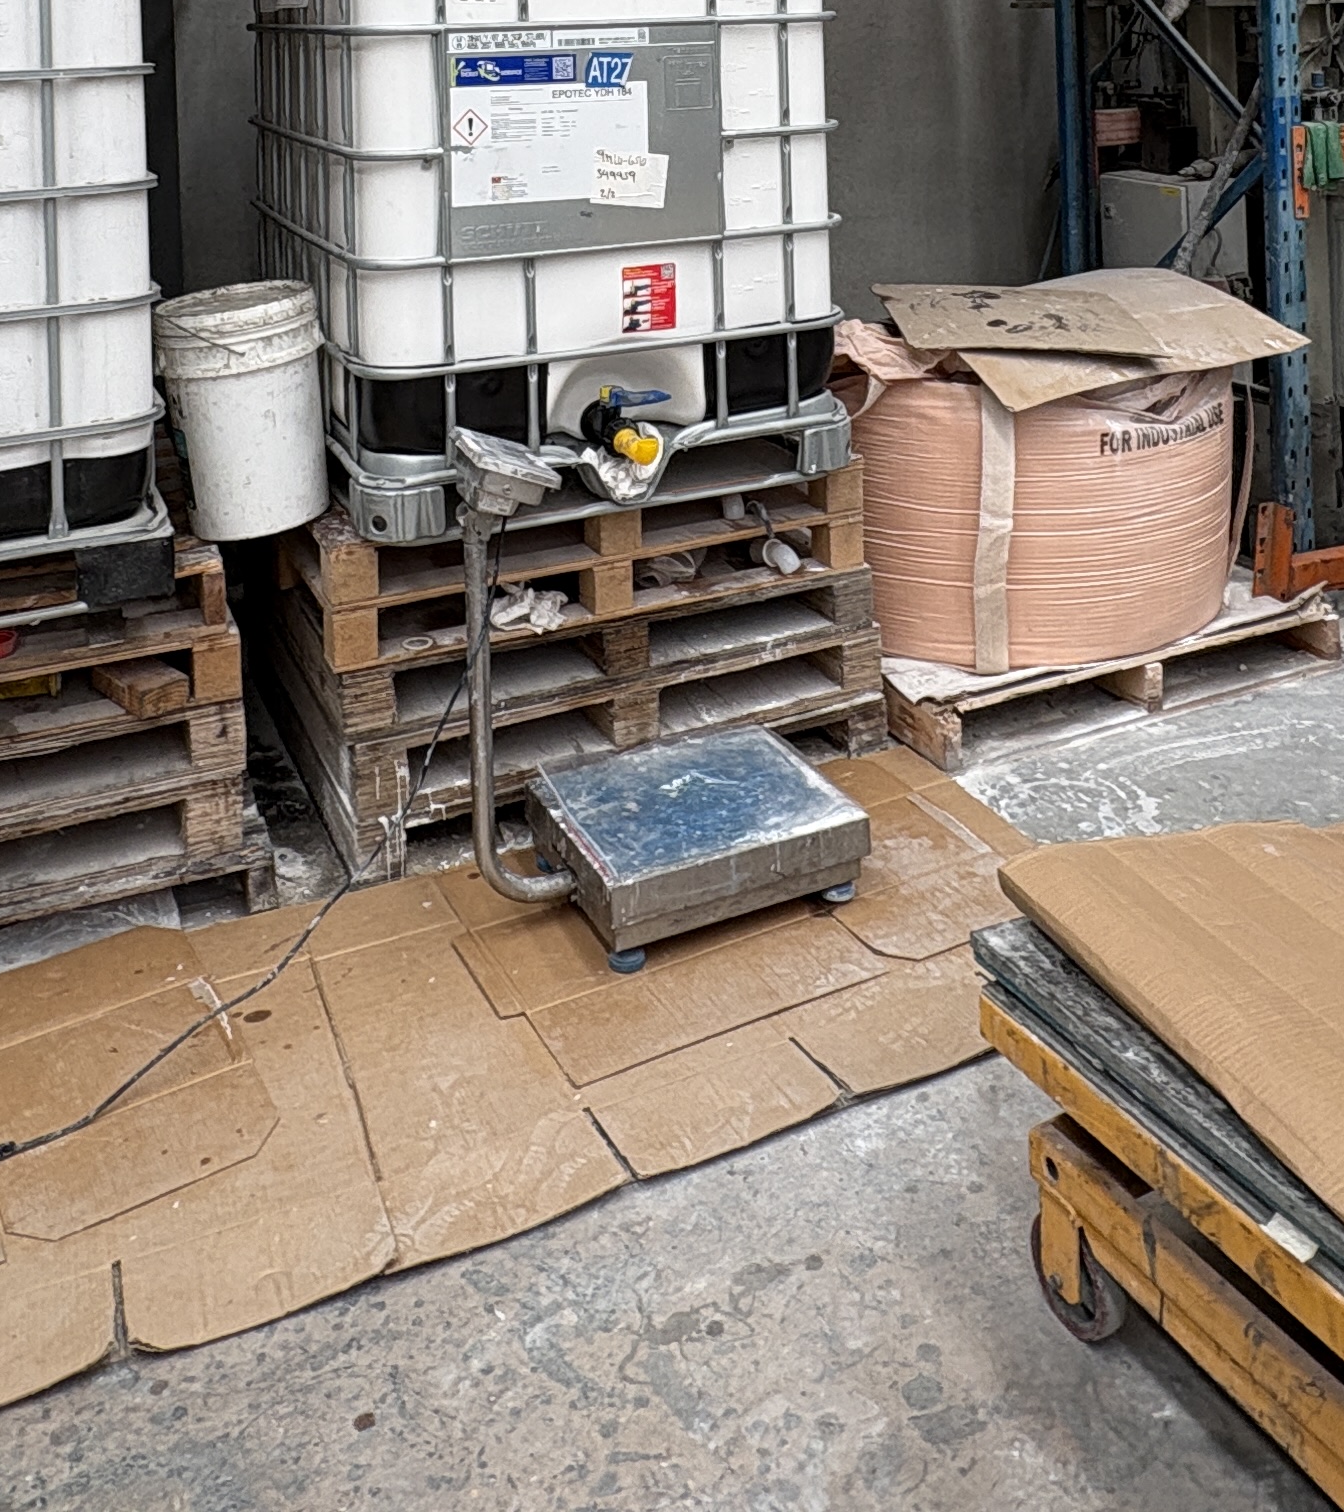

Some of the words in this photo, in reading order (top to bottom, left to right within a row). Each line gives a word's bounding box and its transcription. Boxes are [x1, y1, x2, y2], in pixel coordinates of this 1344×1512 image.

[588, 54, 633, 85] AT27
[552, 90, 591, 99] EPOTEC
[594, 89, 614, 97] YDH
[1100, 430, 1132, 456] FOR
